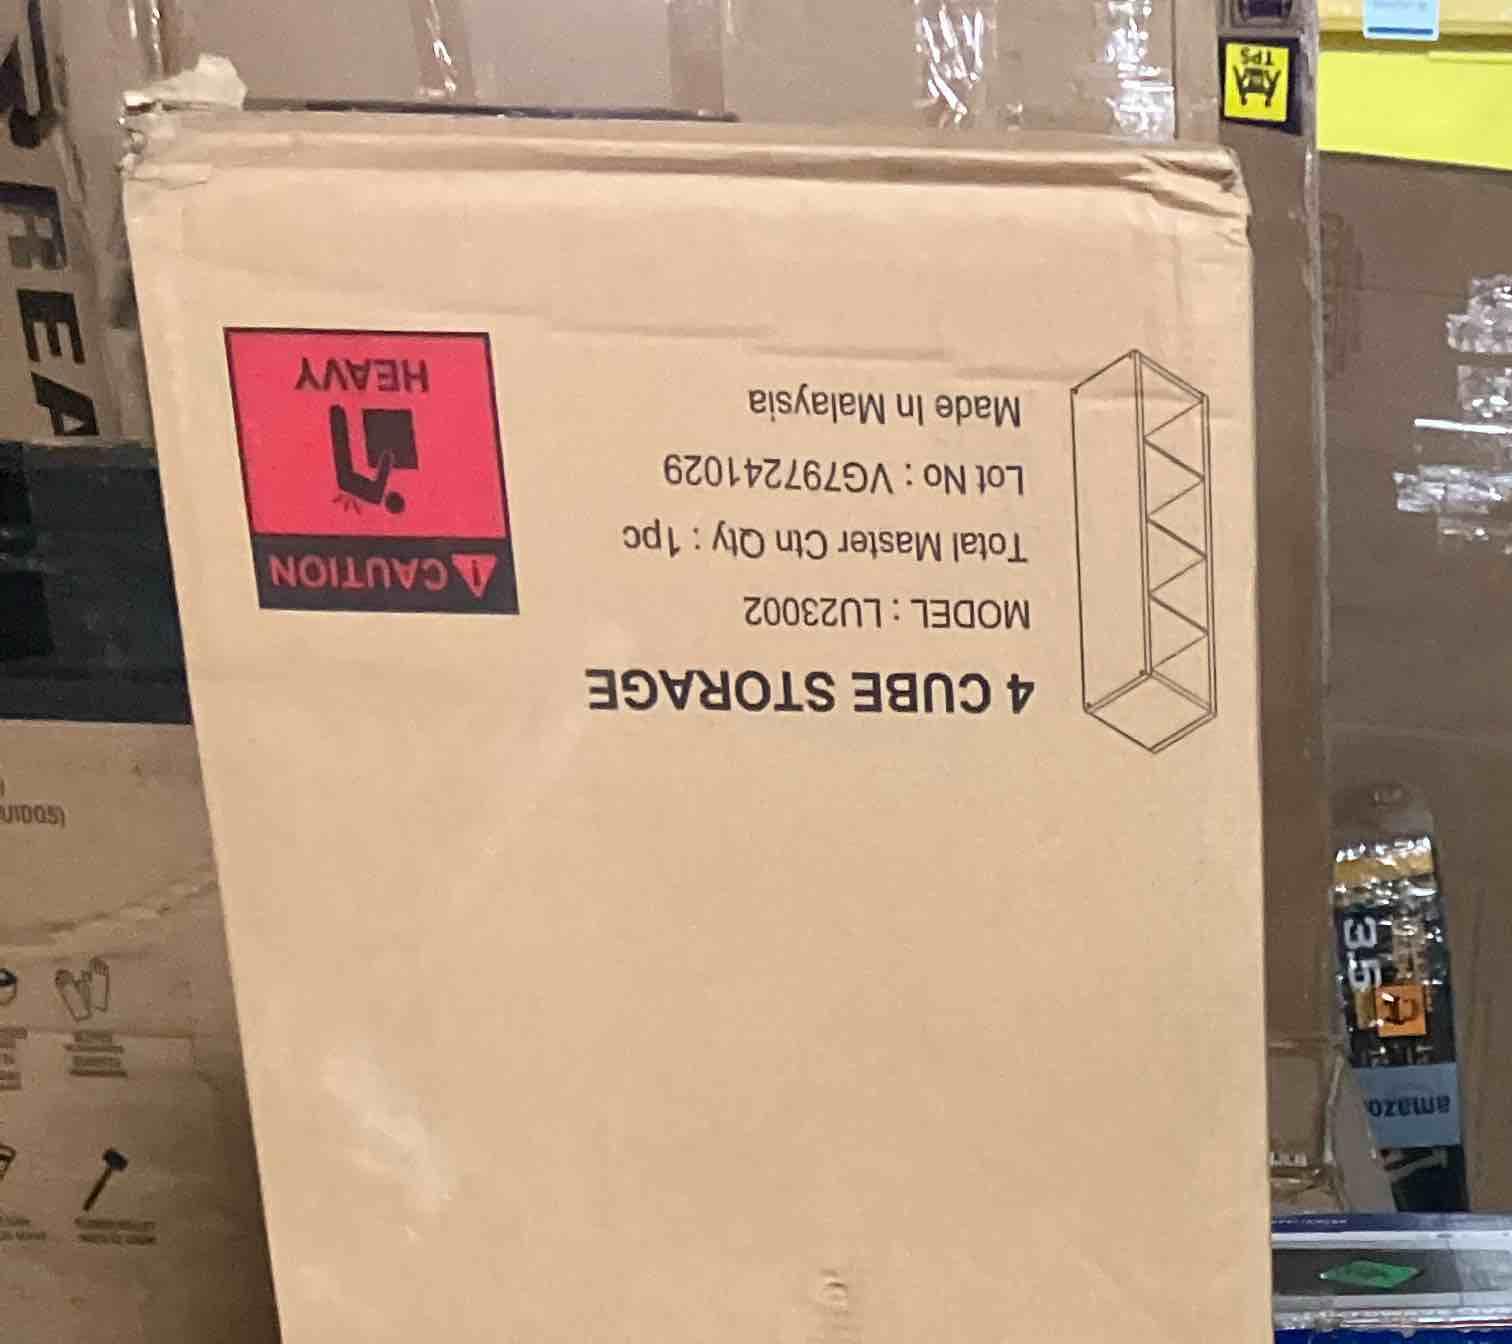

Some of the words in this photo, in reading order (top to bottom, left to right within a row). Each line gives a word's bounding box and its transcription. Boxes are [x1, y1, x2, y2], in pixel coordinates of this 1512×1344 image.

[294, 357, 430, 392] HEAVY
[749, 384, 885, 424] Malaysia
[936, 395, 1020, 427] Made
[664, 454, 893, 494] VG797241029
[924, 464, 966, 495] No
[976, 465, 1023, 496] Lot
[623, 521, 680, 557] 1pc
[712, 521, 764, 558] Qty
[776, 530, 827, 560] Ctn
[838, 531, 941, 562] Master
[953, 533, 1028, 563] Total
[268, 554, 449, 591] CAUTION
[744, 597, 881, 628] LU23002
[918, 599, 1030, 629] MODEL
[585, 669, 835, 712] STORAGE
[852, 672, 991, 714] CUBE
[1007, 677, 1034, 714] 4
[1363, 1095, 1451, 1118] amazo
